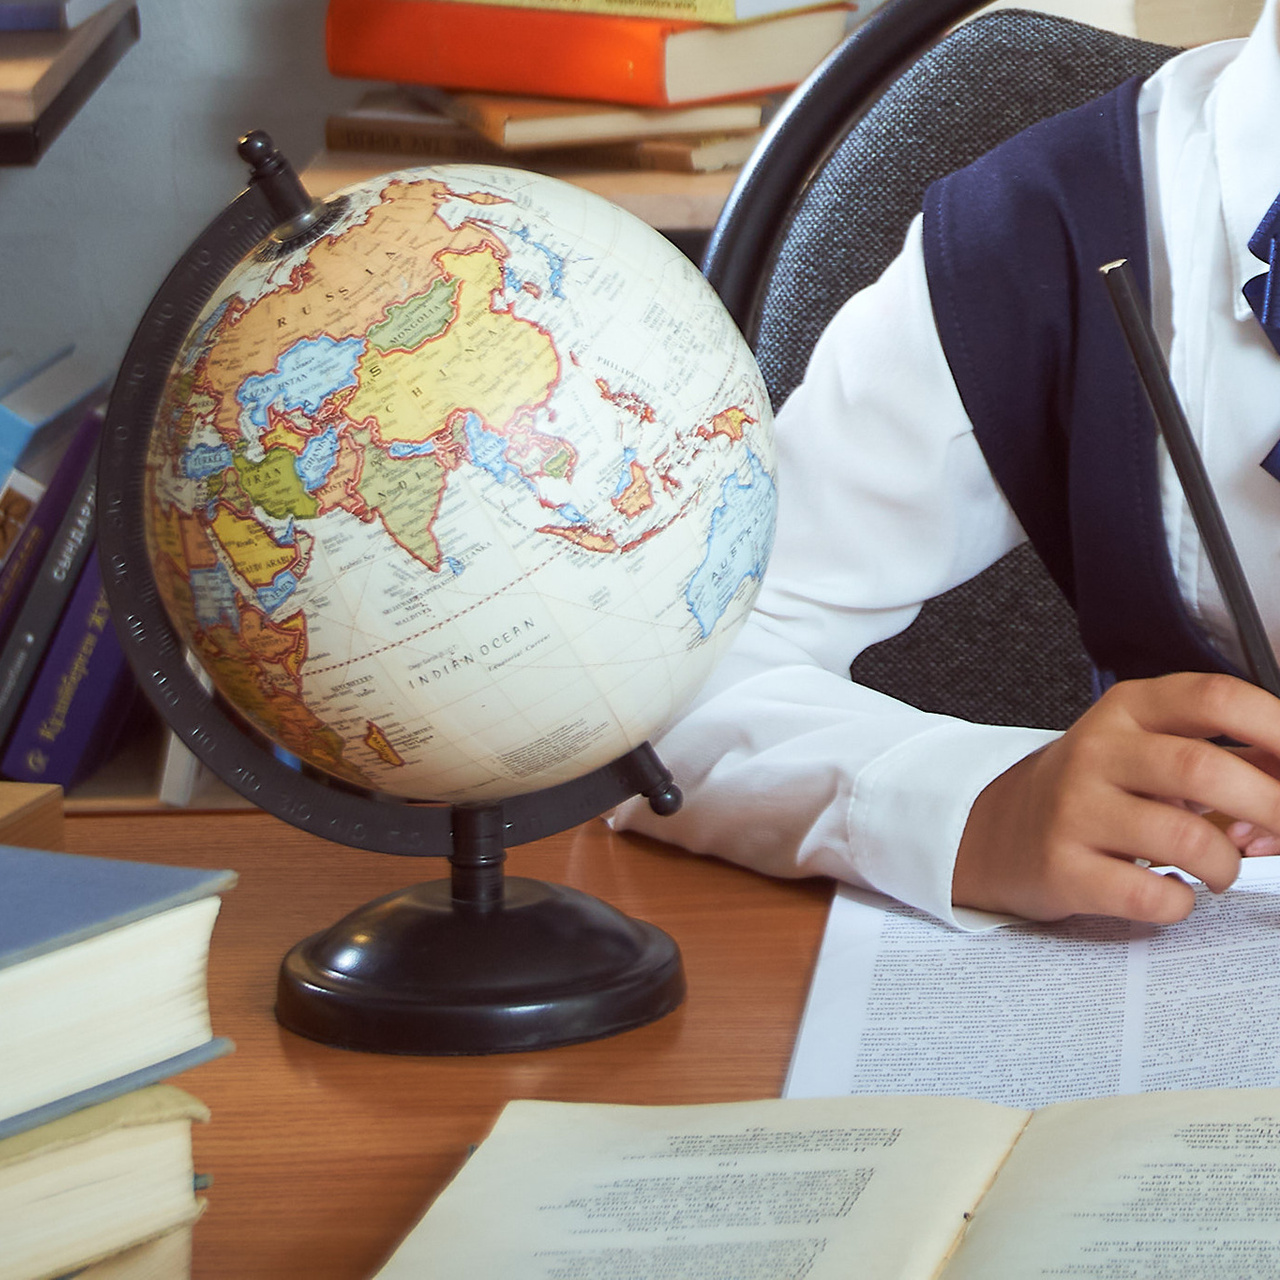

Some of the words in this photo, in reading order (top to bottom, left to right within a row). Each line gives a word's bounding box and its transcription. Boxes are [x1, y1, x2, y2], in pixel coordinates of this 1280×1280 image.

[277, 251, 396, 328] RUSSIA
[385, 329, 498, 413] CHINA
[246, 468, 282, 487] IRAN
[270, 580, 295, 600] YEMEN
[408, 653, 475, 690] INDIAN
[480, 617, 536, 656] OCEAN
